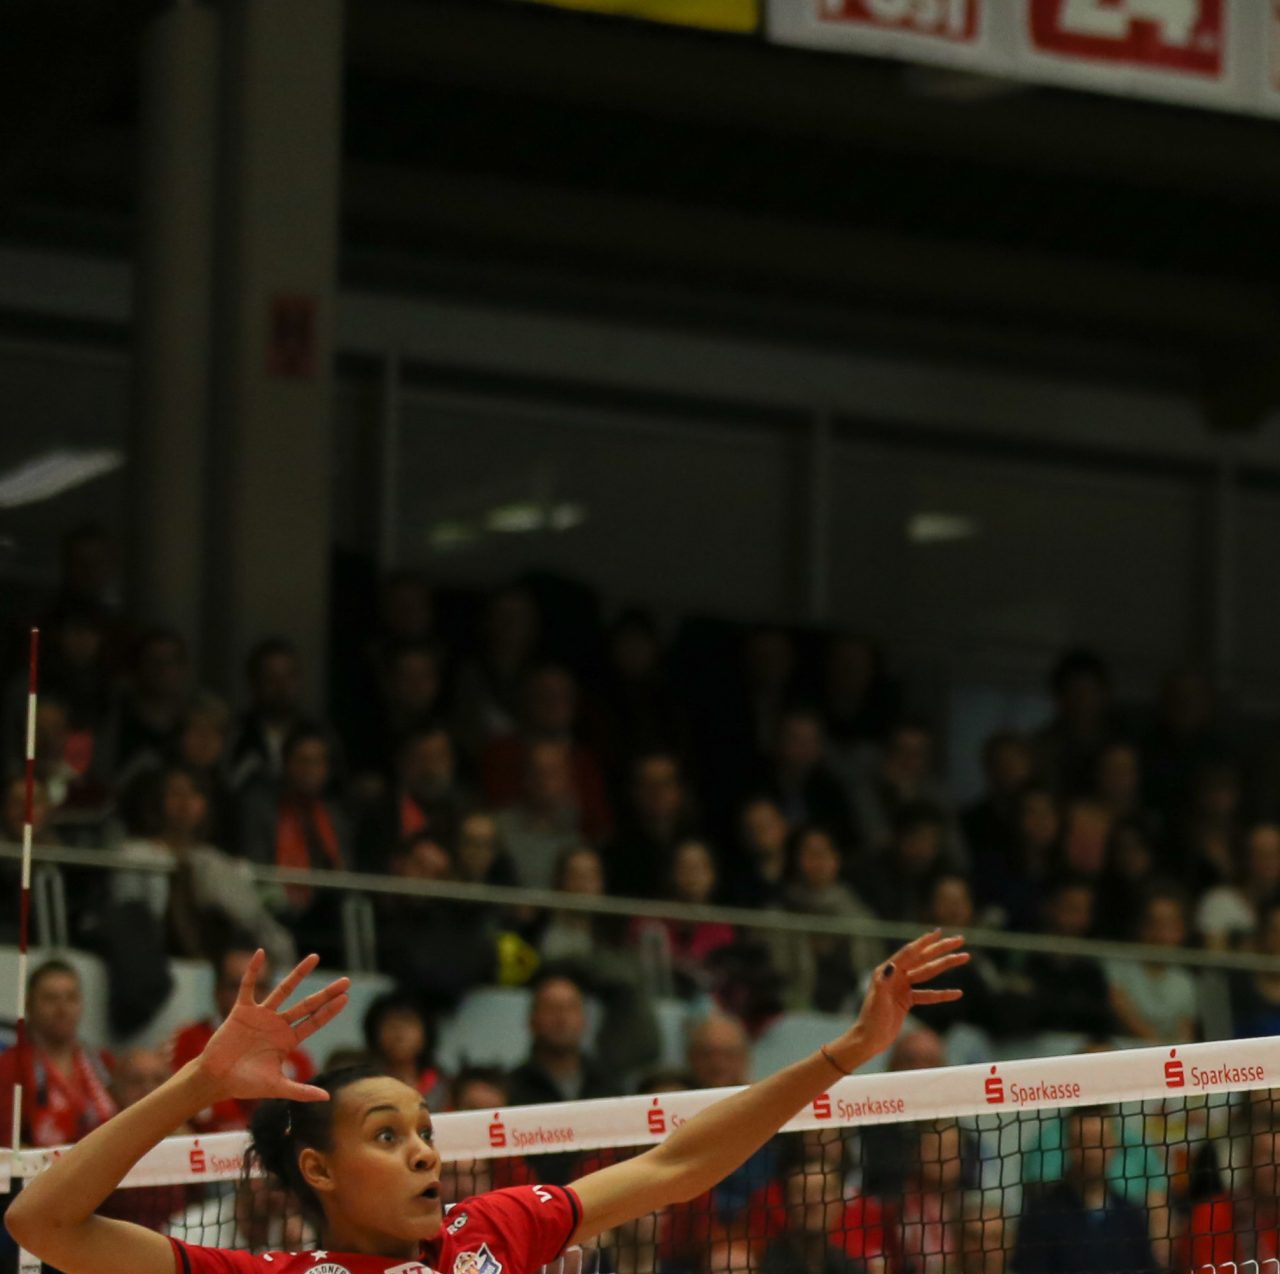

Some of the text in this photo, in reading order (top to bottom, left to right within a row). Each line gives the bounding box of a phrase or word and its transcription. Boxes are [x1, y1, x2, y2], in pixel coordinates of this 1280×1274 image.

[1191, 1063, 1265, 1087] Sparkasse
[1010, 1080, 1081, 1103] Sparkasse
[837, 1096, 905, 1119] Sparkasse
[512, 1126, 575, 1148] Sparkasse
